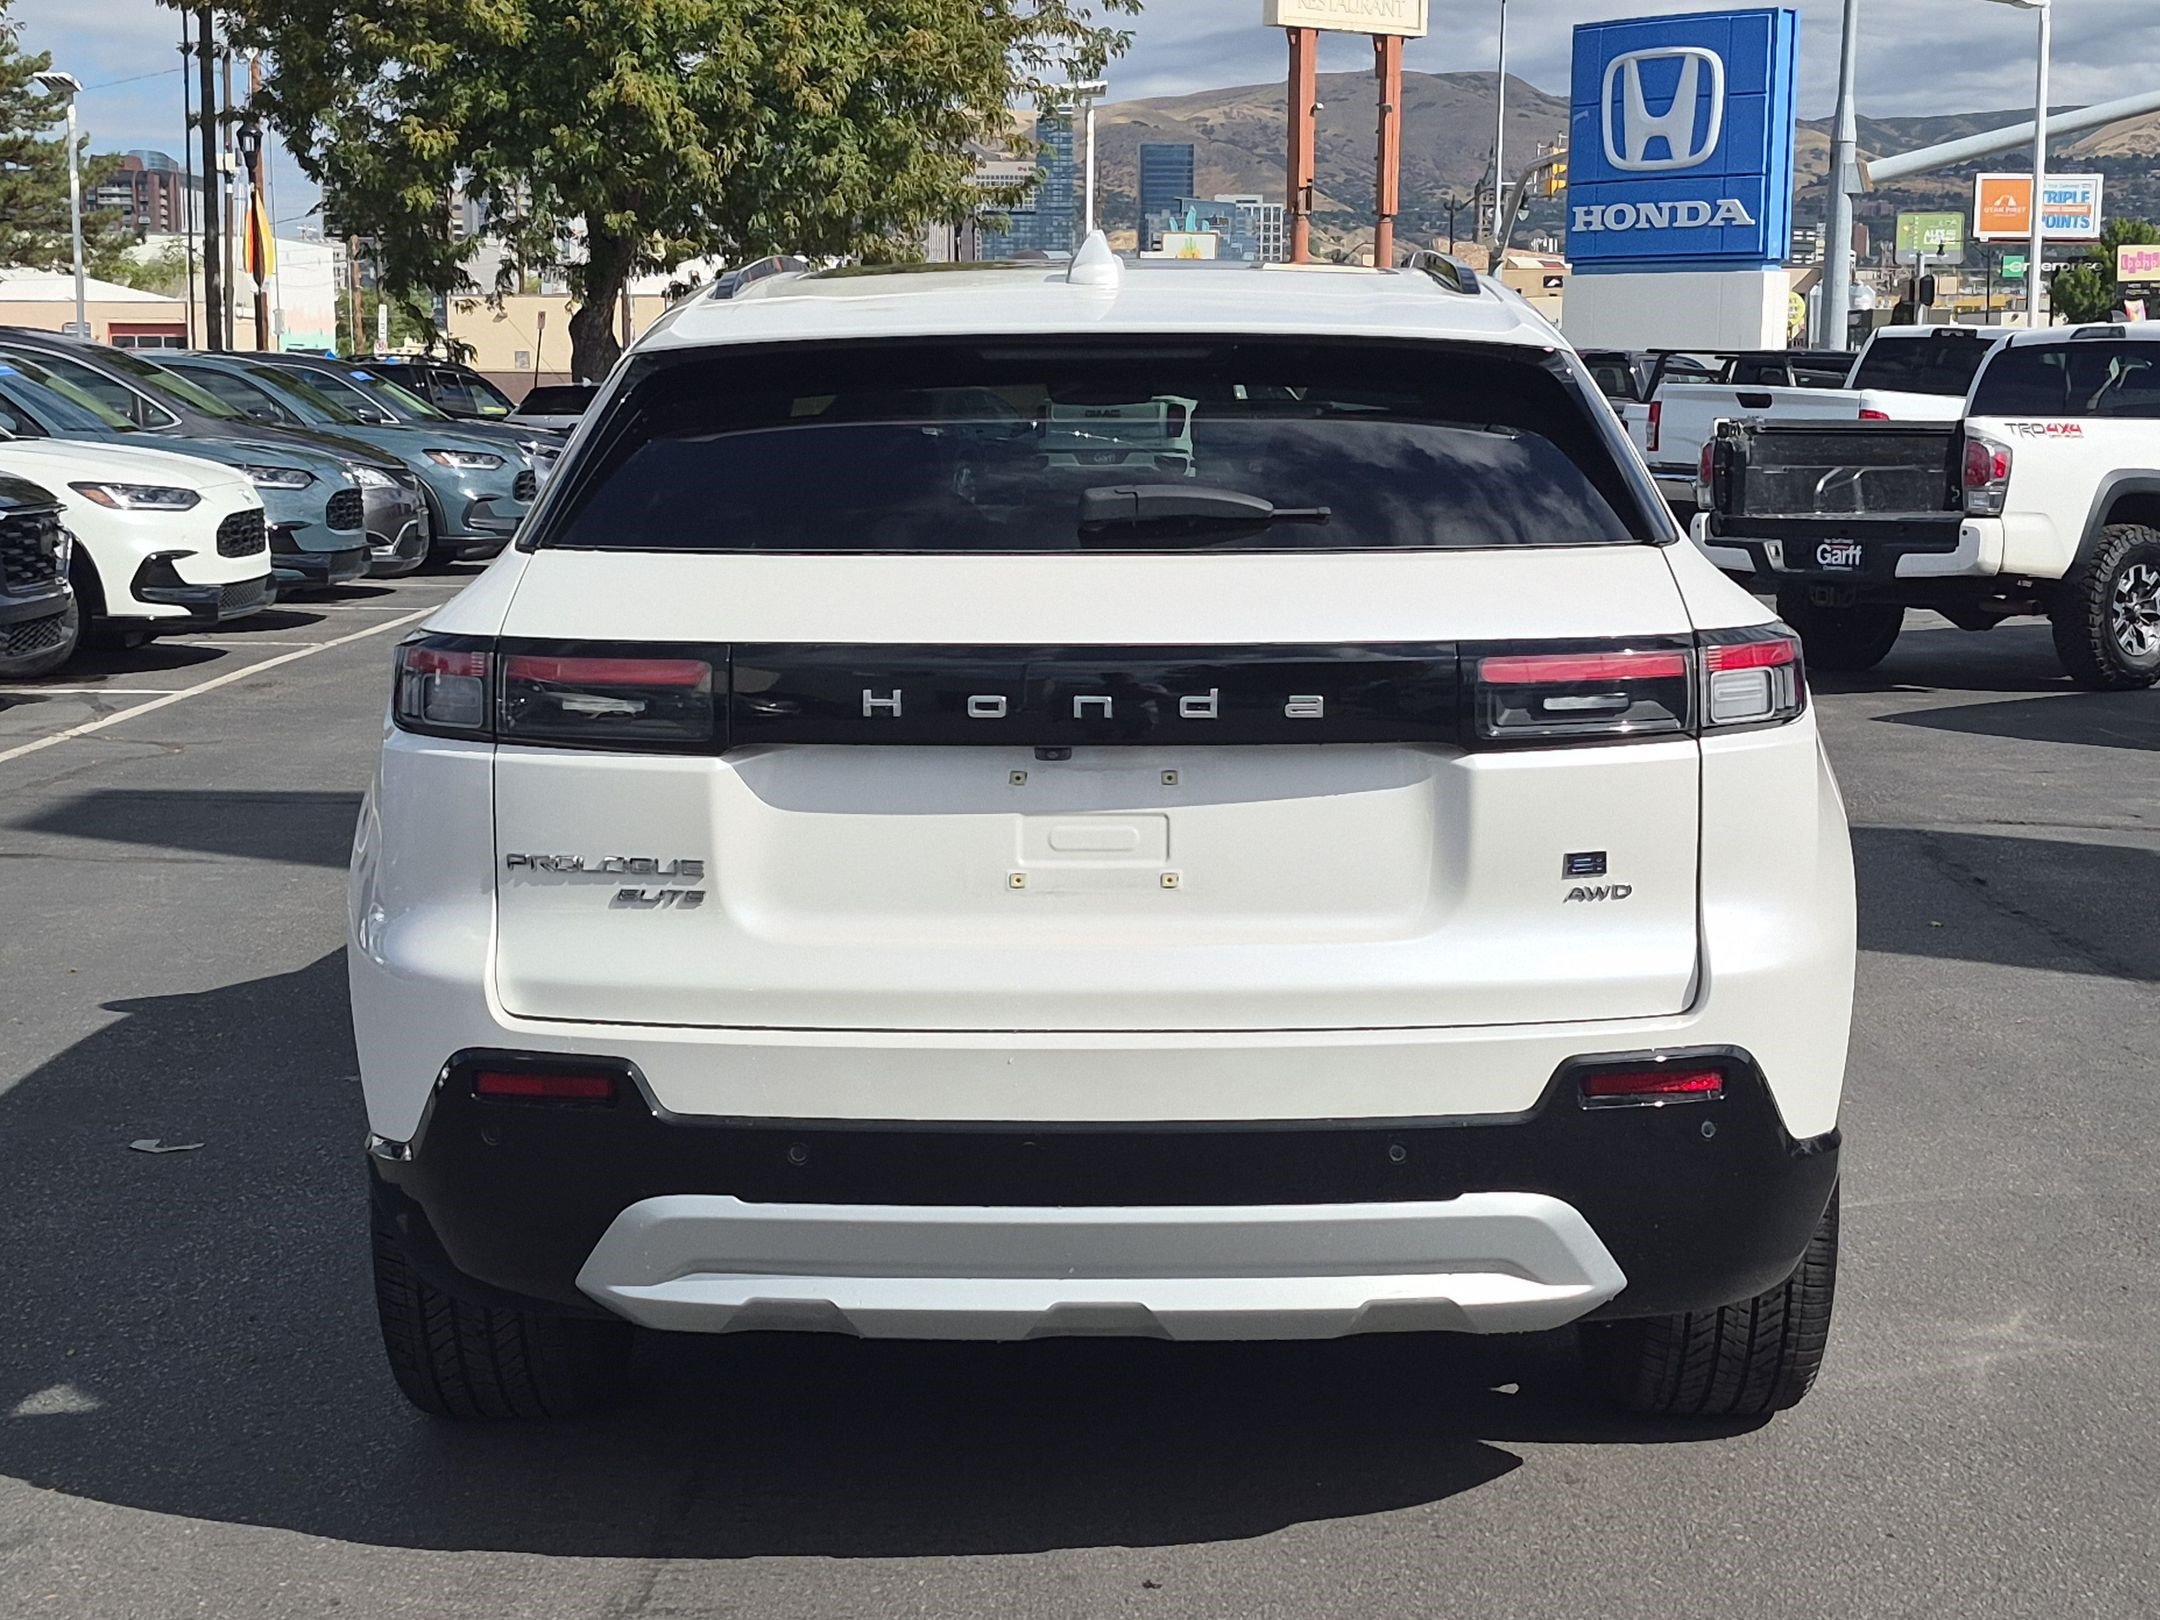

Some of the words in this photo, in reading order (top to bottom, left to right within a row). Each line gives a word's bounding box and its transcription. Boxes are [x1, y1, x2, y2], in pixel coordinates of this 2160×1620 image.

[1571, 199, 1756, 232] HONDA
[2004, 422, 2046, 438] TRD
[1816, 543, 1862, 566] Garff
[862, 688, 1325, 719] Honda
[506, 853, 704, 878] PROLOGUE
[617, 888, 705, 903] ELITE
[1562, 884, 1633, 904] AWD
